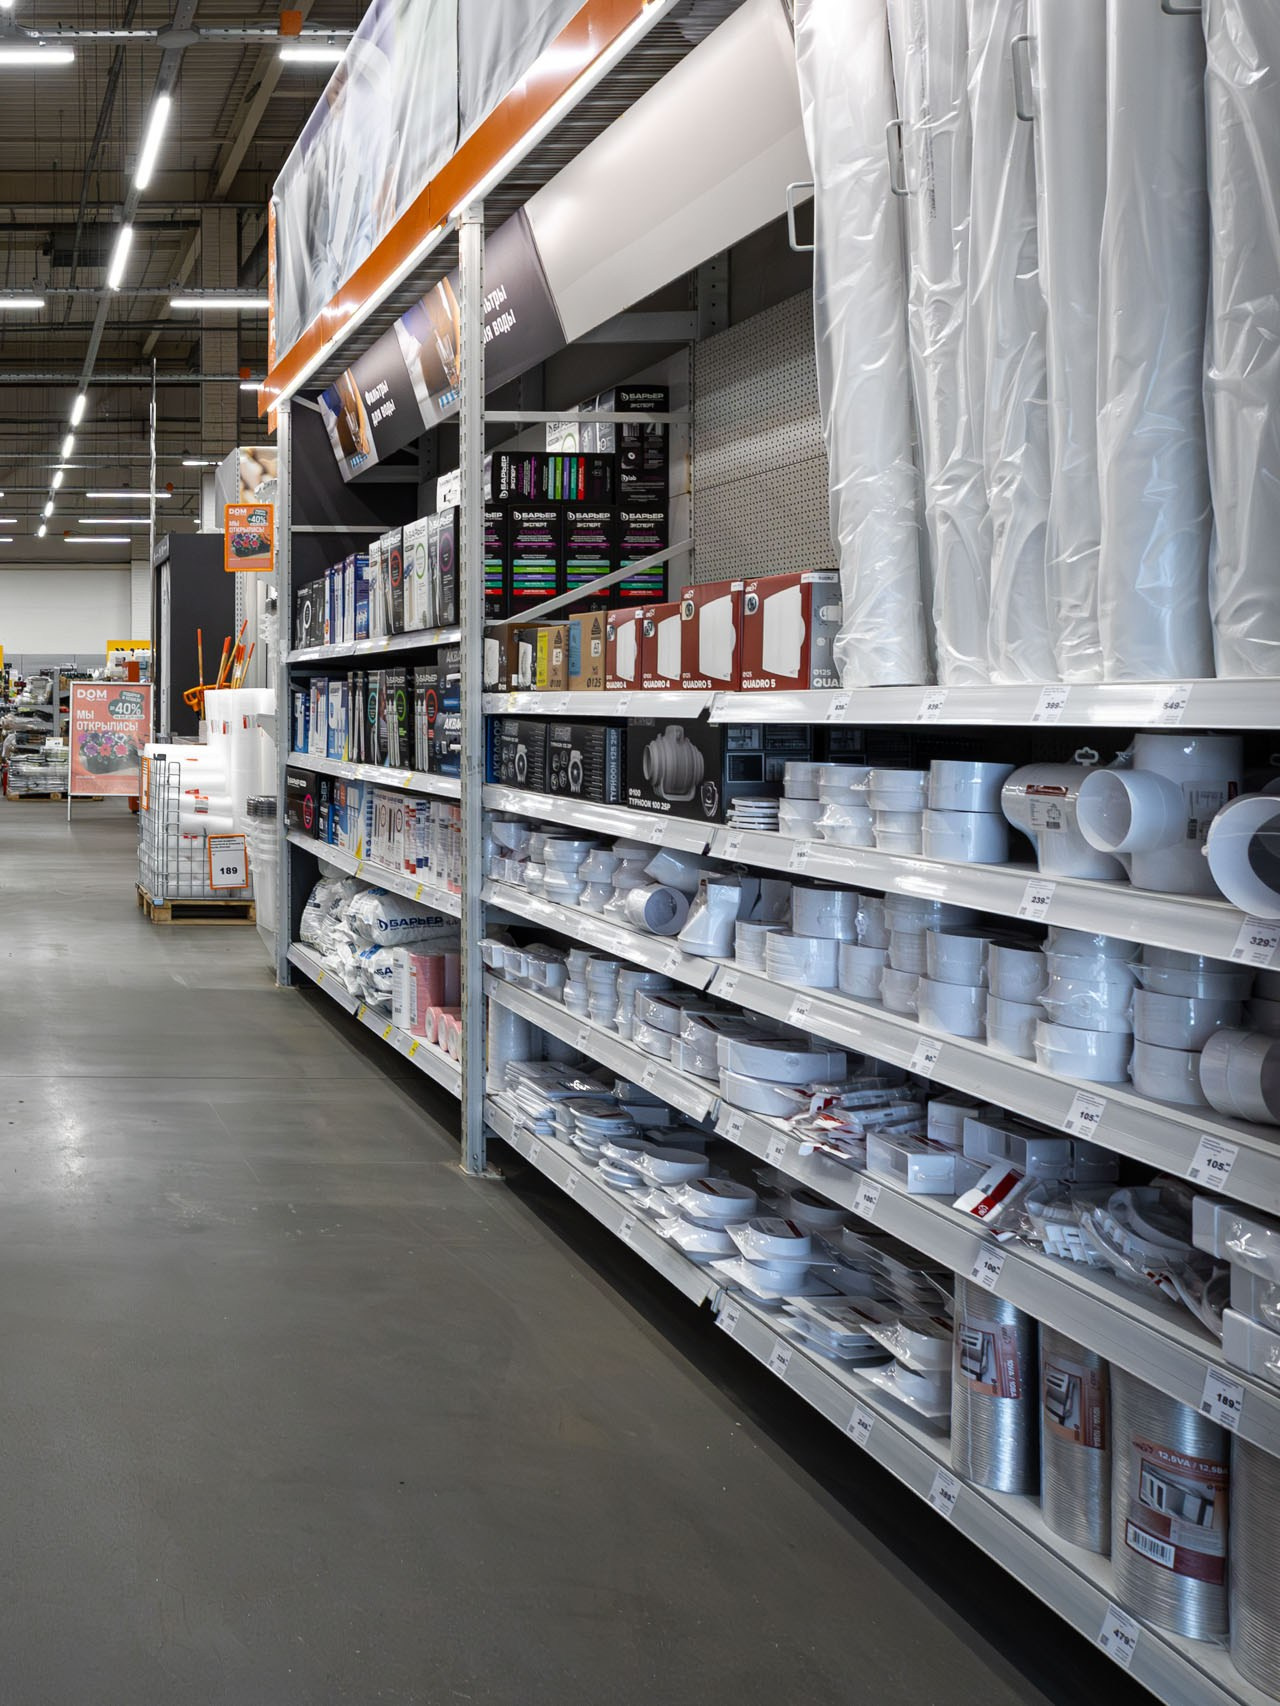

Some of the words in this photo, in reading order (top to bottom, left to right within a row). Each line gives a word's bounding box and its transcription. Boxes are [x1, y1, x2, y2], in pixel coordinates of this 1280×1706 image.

[493, 308, 517, 338] воды
[364, 380, 390, 406] Фильтры
[629, 392, 664, 400] БАРЬЕР
[382, 399, 397, 420] воды
[522, 512, 556, 520] БАРЬЕР
[576, 512, 610, 520] БАРЬЕР
[643, 680, 665, 688] QUADRO
[665, 680, 670, 688] 4
[682, 680, 706, 689] QUADRO
[706, 680, 712, 688] 5
[742, 679, 770, 689] QUADRO
[770, 678, 776, 688] 5
[76, 689, 108, 700] DOM
[115, 702, 142, 715] 40%
[76, 710, 95, 719] МЫ
[76, 721, 139, 731] ОТКРЫЛИСЬ!
[628, 797, 651, 809] TYPHOON
[219, 866, 238, 875] 189
[389, 916, 444, 927] БАРЬЕР
